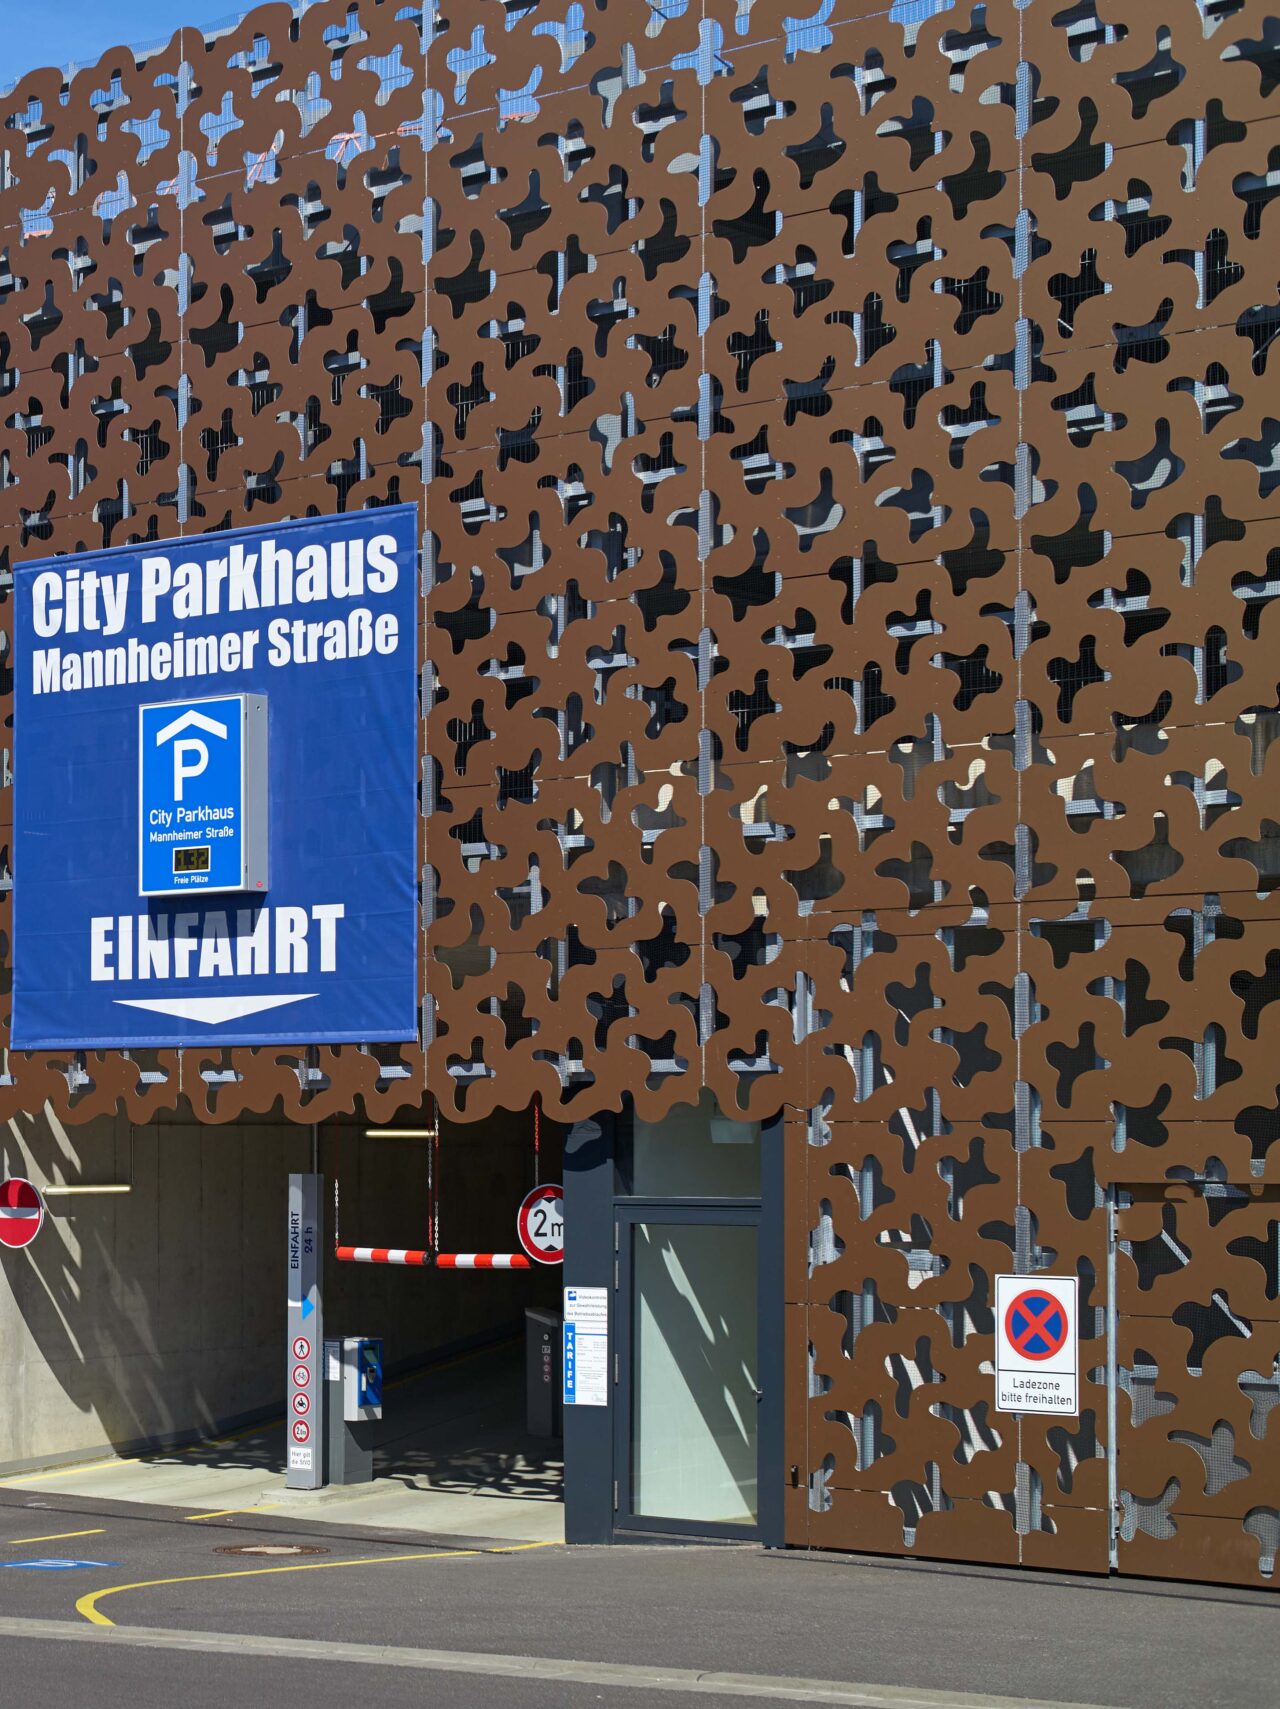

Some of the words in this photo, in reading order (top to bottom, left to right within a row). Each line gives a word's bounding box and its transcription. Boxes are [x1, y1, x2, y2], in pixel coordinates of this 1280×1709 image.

[32, 569, 129, 638] City
[141, 534, 399, 624] Parkhaus
[32, 629, 259, 695] Mannheimer
[268, 608, 399, 668] Straße
[174, 738, 209, 802] P
[149, 809, 173, 828] City
[177, 805, 235, 823] Parkhaus
[149, 829, 203, 843] Mannheimer
[206, 826, 234, 838] Straße
[174, 875, 189, 884] Freie
[191, 874, 209, 883] Plätze
[90, 903, 345, 982] EINFAHRT
[290, 1211, 300, 1269] EINFAHRT
[304, 1226, 313, 1234] h
[304, 1238, 313, 1254] 24
[566, 1332, 574, 1388] TARIFE
[1012, 1377, 1060, 1391] Ladezone
[1001, 1391, 1022, 1403] bitte
[1025, 1392, 1072, 1406] freihalten
